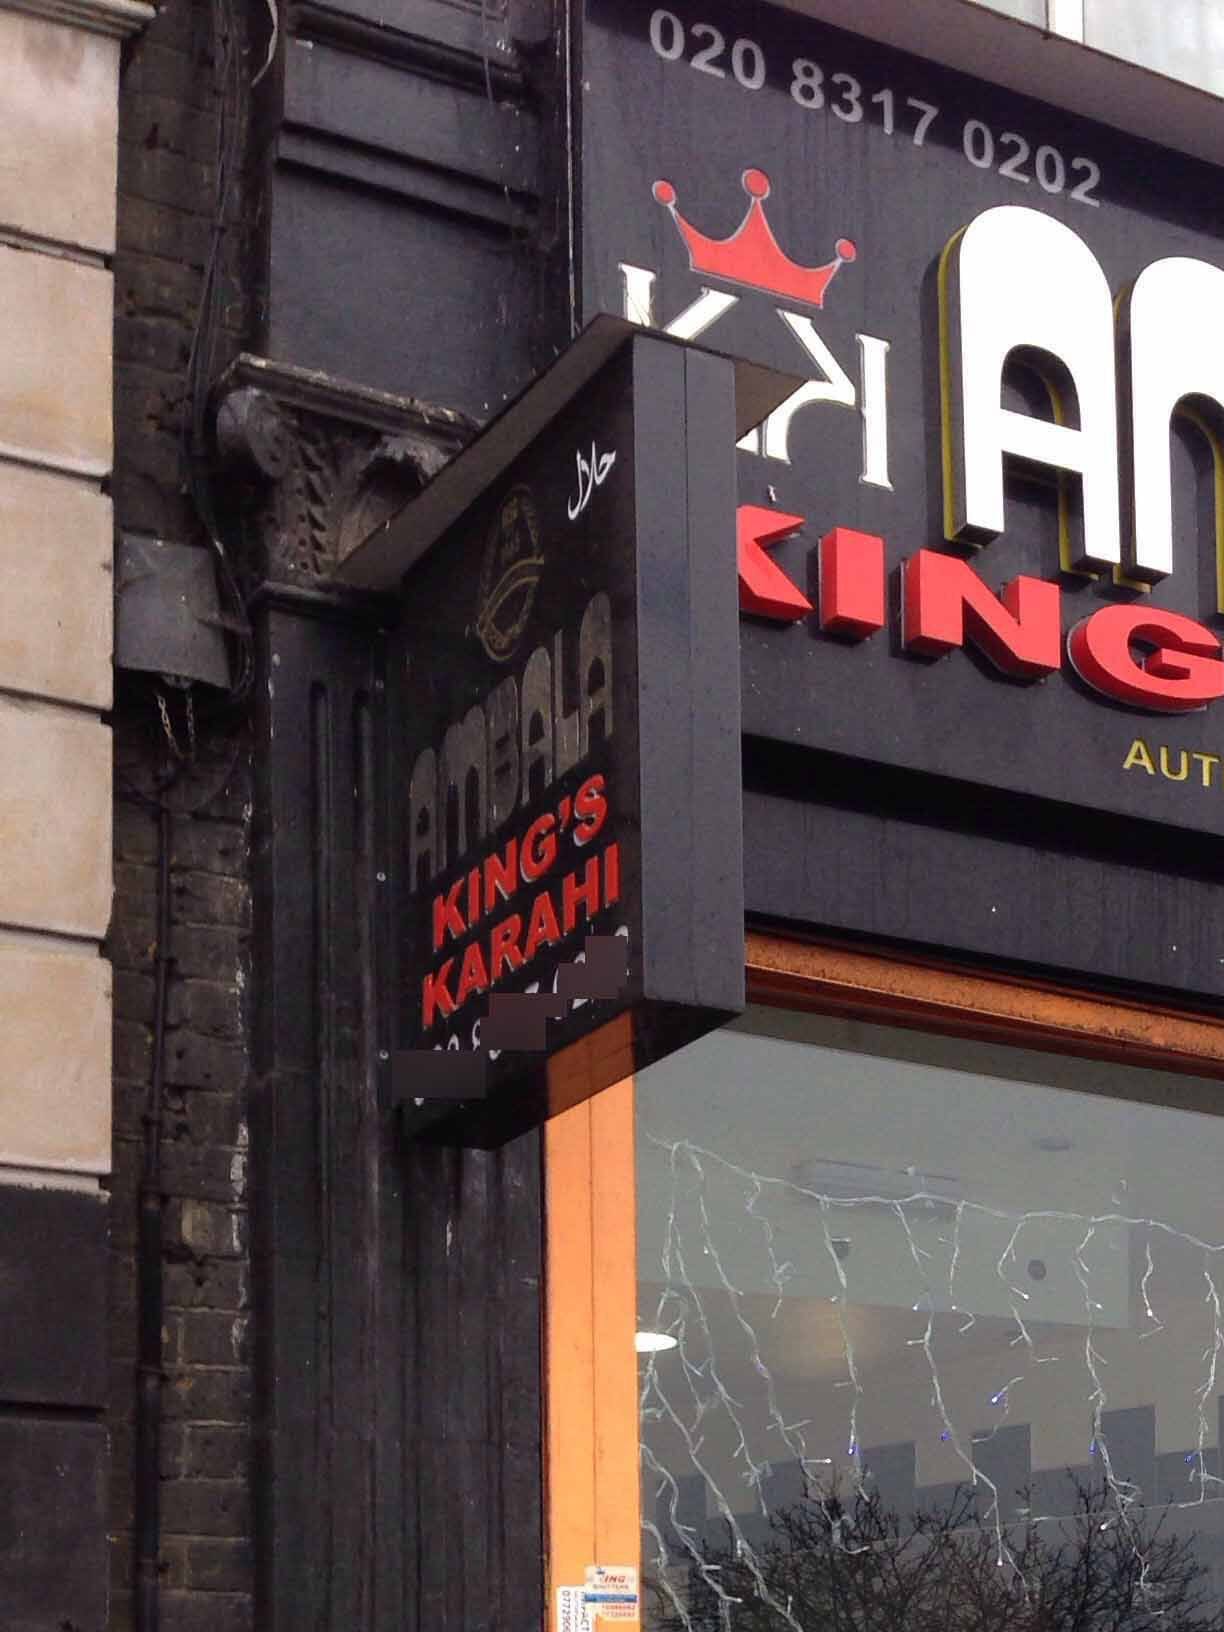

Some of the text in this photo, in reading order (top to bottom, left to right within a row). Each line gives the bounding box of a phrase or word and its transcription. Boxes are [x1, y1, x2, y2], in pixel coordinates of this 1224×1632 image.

[649, 8, 1101, 208] 020 8317 0202
[408, 592, 614, 893] AMBALA
[420, 841, 622, 1031] KARAHI
[432, 773, 608, 953] KING'S
